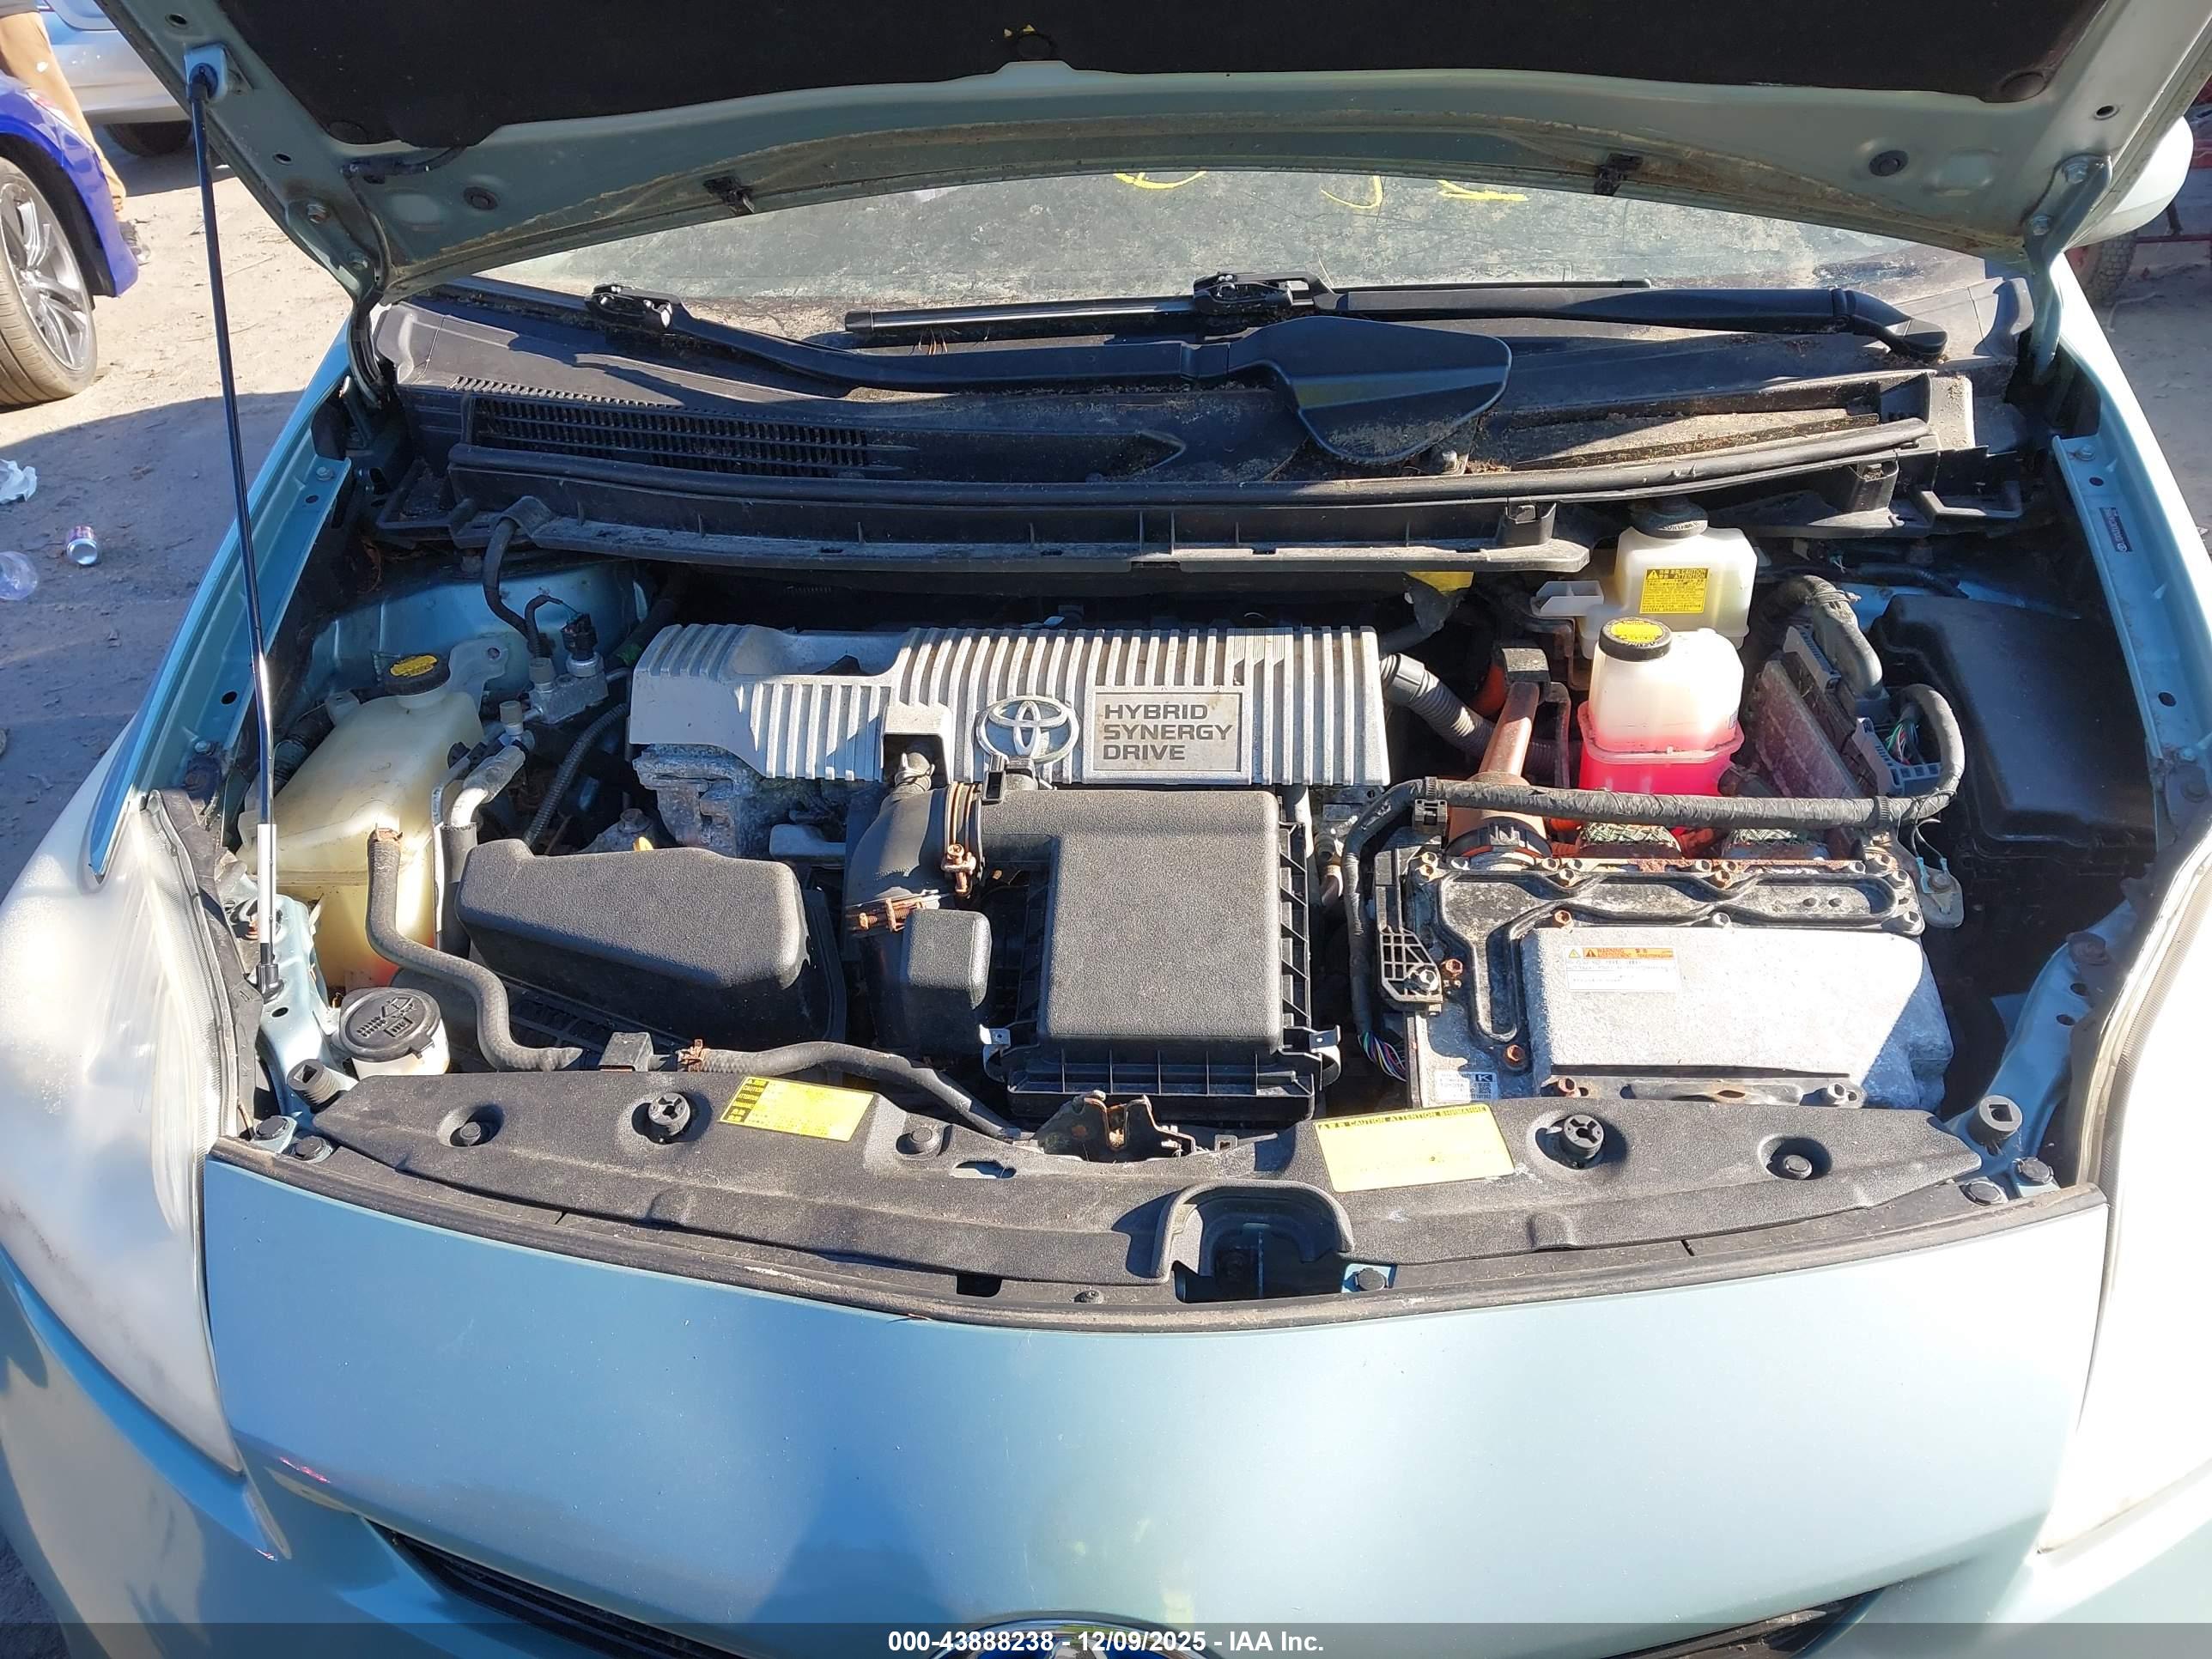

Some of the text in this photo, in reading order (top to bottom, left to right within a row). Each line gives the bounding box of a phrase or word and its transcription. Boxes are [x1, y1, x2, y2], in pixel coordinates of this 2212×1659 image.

[1104, 704, 1208, 720] HYBRID
[1103, 724, 1233, 740] SYNERGY
[1103, 744, 1186, 760] DRIVE
[1351, 1117, 1385, 1127] CAUTION
[1390, 1111, 1437, 1122] ATTENTION
